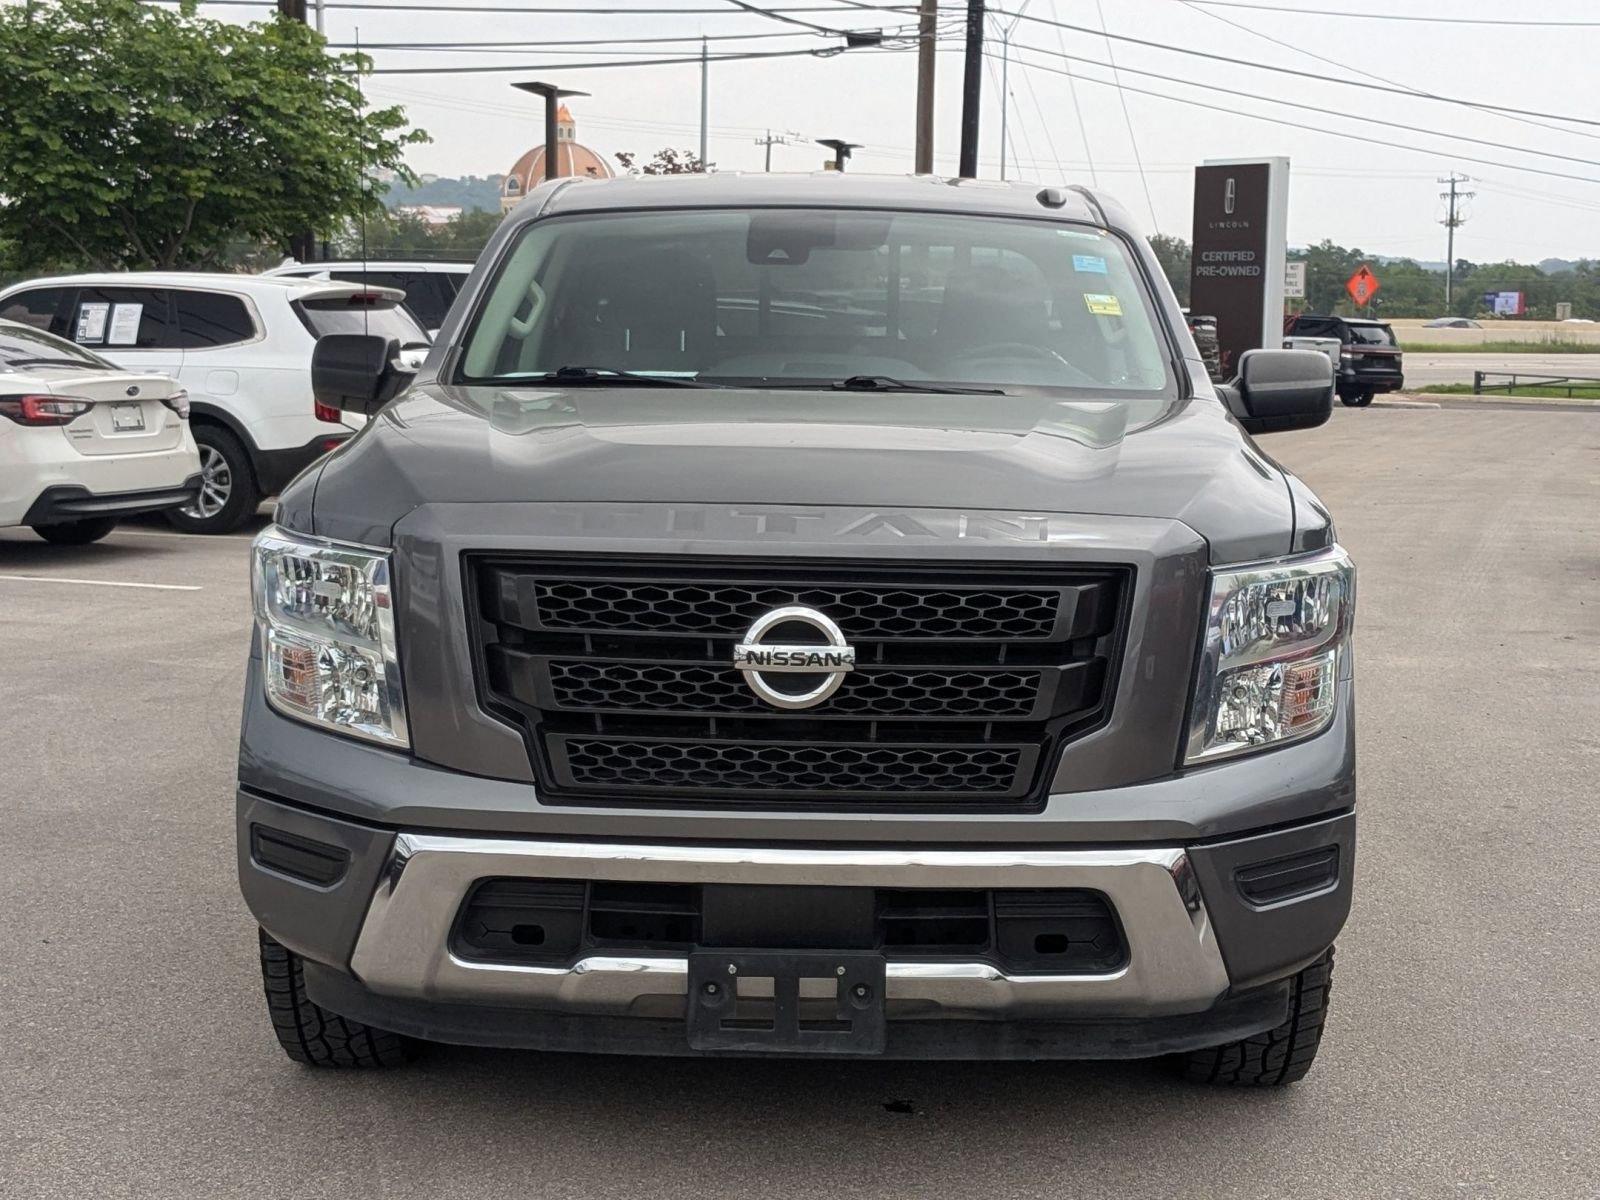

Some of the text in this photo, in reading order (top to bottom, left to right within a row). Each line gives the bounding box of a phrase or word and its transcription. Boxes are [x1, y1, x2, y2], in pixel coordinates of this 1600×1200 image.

[1209, 221, 1249, 229] LINCOLN
[1202, 251, 1255, 262] CERTIFIED
[1196, 265, 1260, 276] PRE-OWNED
[552, 506, 1048, 542] TITAN
[746, 650, 842, 667] NISSAN
